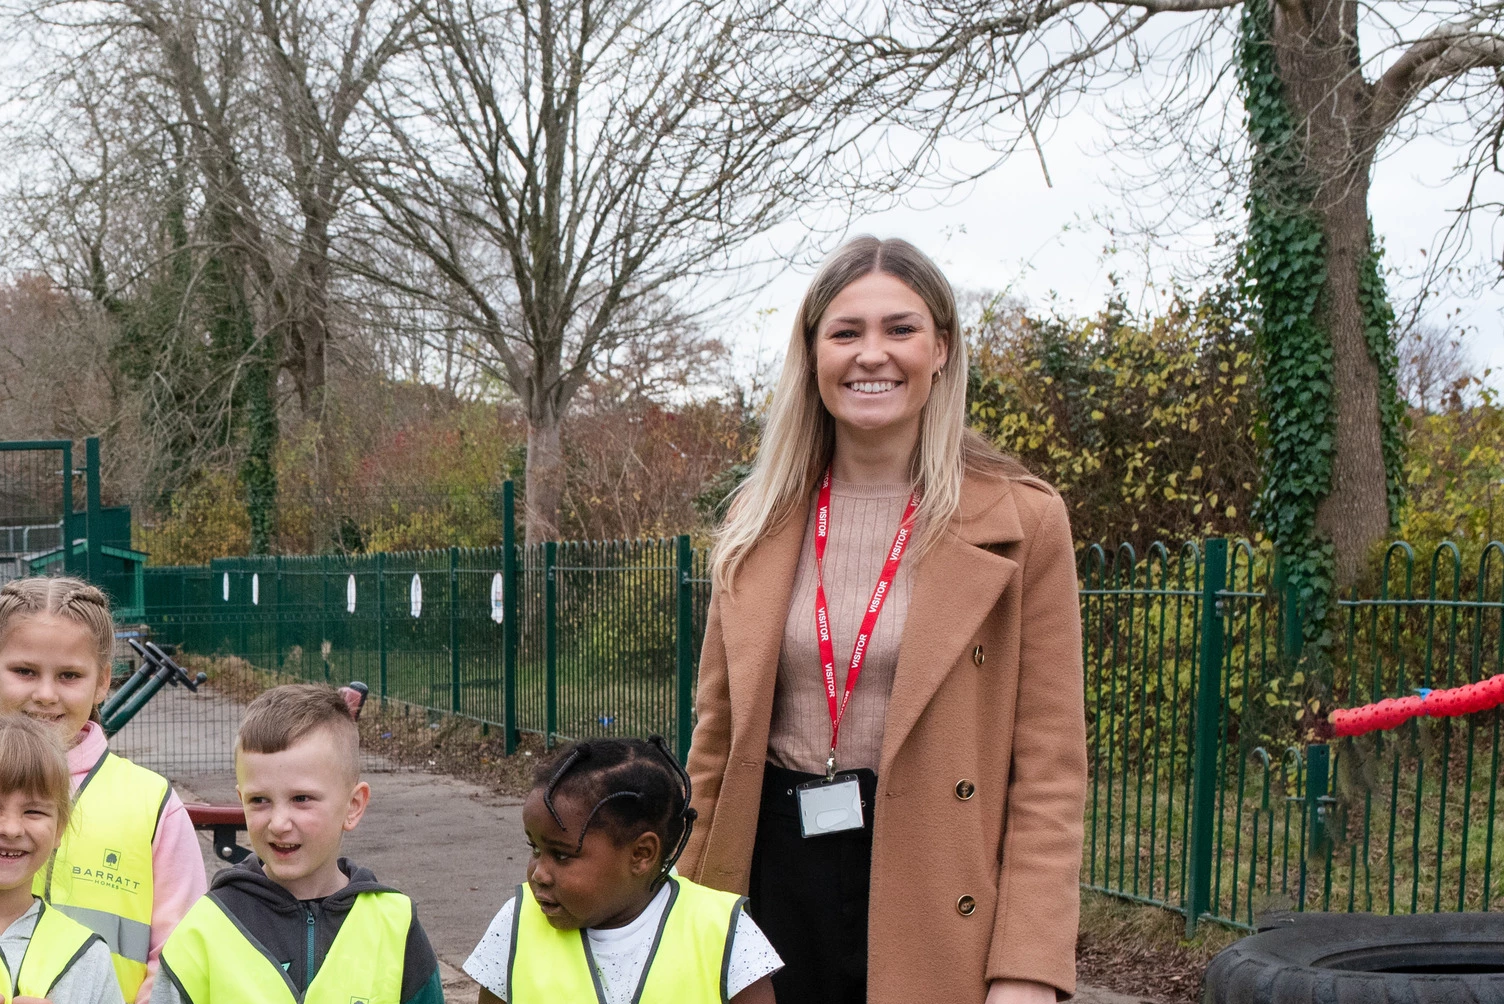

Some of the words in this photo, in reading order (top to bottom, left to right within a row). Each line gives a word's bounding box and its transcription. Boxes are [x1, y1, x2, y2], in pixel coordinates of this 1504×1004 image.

[818, 505, 828, 537] VISITOR
[889, 528, 909, 562] VISITOR
[868, 580, 888, 614] VISITOR
[818, 607, 829, 642] VISITOR
[851, 634, 868, 669] VISITOR
[824, 662, 836, 698] VISITOR
[72, 866, 140, 890] BARRATT
[94, 879, 119, 890] HOMES
